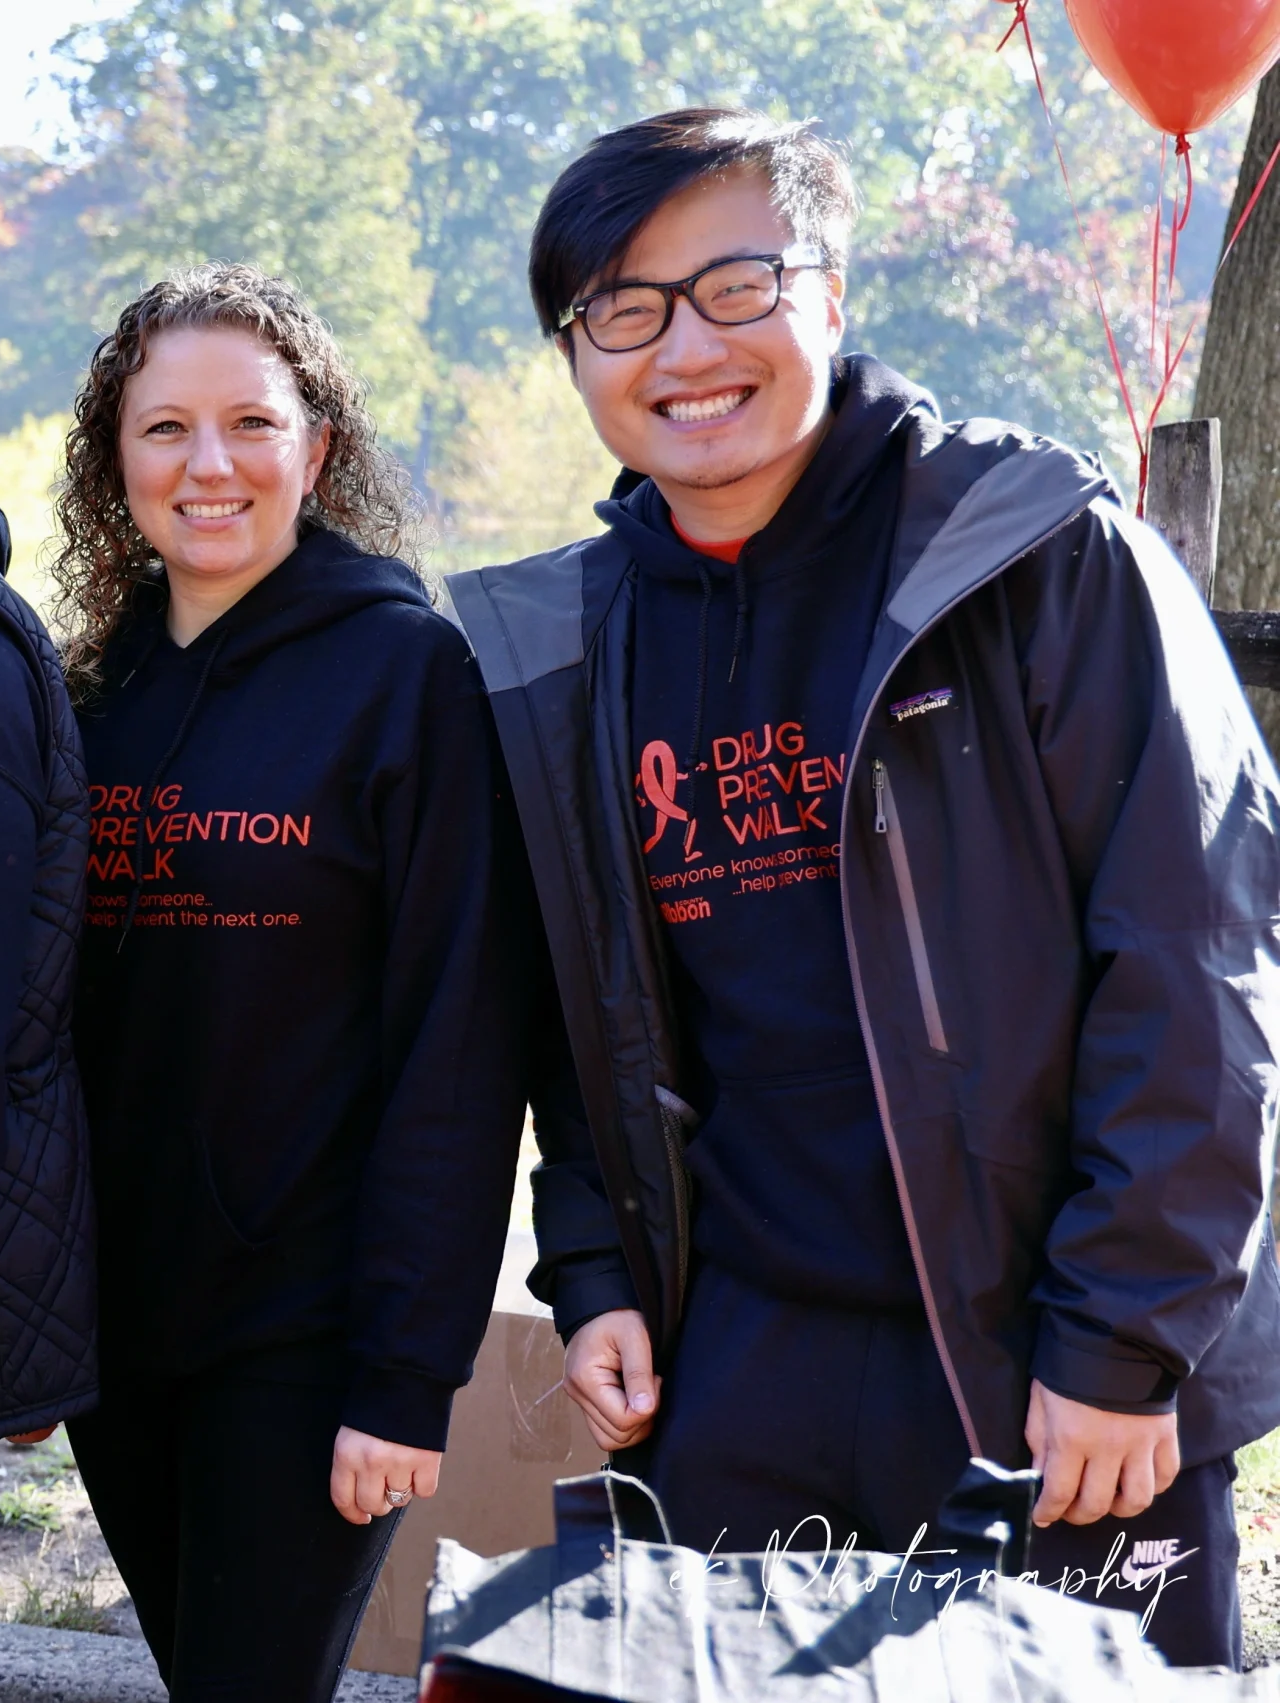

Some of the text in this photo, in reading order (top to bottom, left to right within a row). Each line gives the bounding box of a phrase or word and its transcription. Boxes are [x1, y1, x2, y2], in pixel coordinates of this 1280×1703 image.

[897, 697, 949, 721] patagonia
[713, 721, 805, 771] DRUG
[723, 797, 827, 845] WALK
[180, 910, 208, 926] the
[213, 912, 257, 926] next
[262, 912, 302, 926] one.
[1131, 1538, 1180, 1564] NIKE
